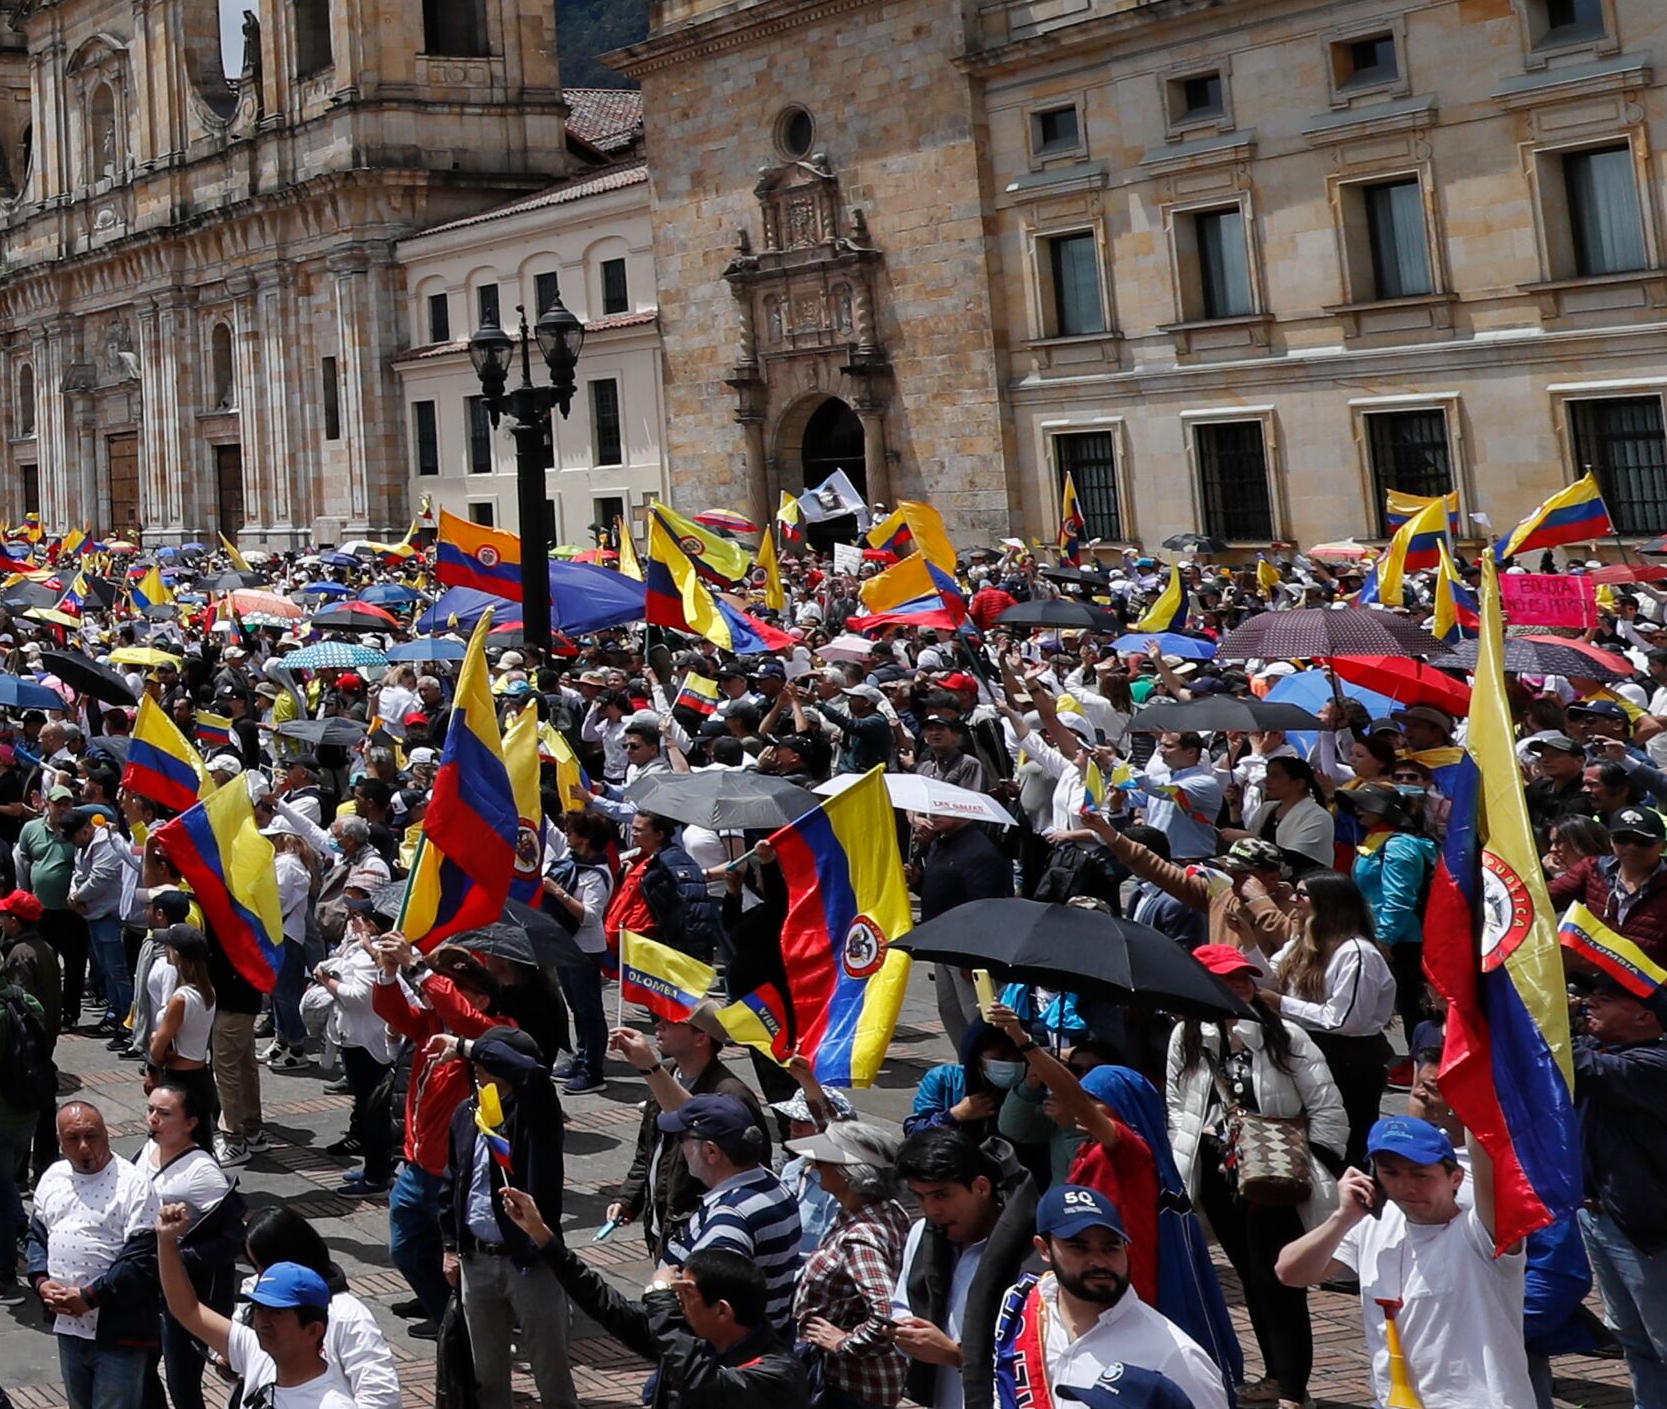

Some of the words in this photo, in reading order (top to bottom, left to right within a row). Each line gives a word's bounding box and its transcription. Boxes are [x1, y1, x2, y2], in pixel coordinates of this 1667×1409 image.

[1486, 857, 1525, 928] PUBLICA
[1574, 927, 1640, 976] COLOMBIA
[1064, 1190, 1096, 1207] 5Q
